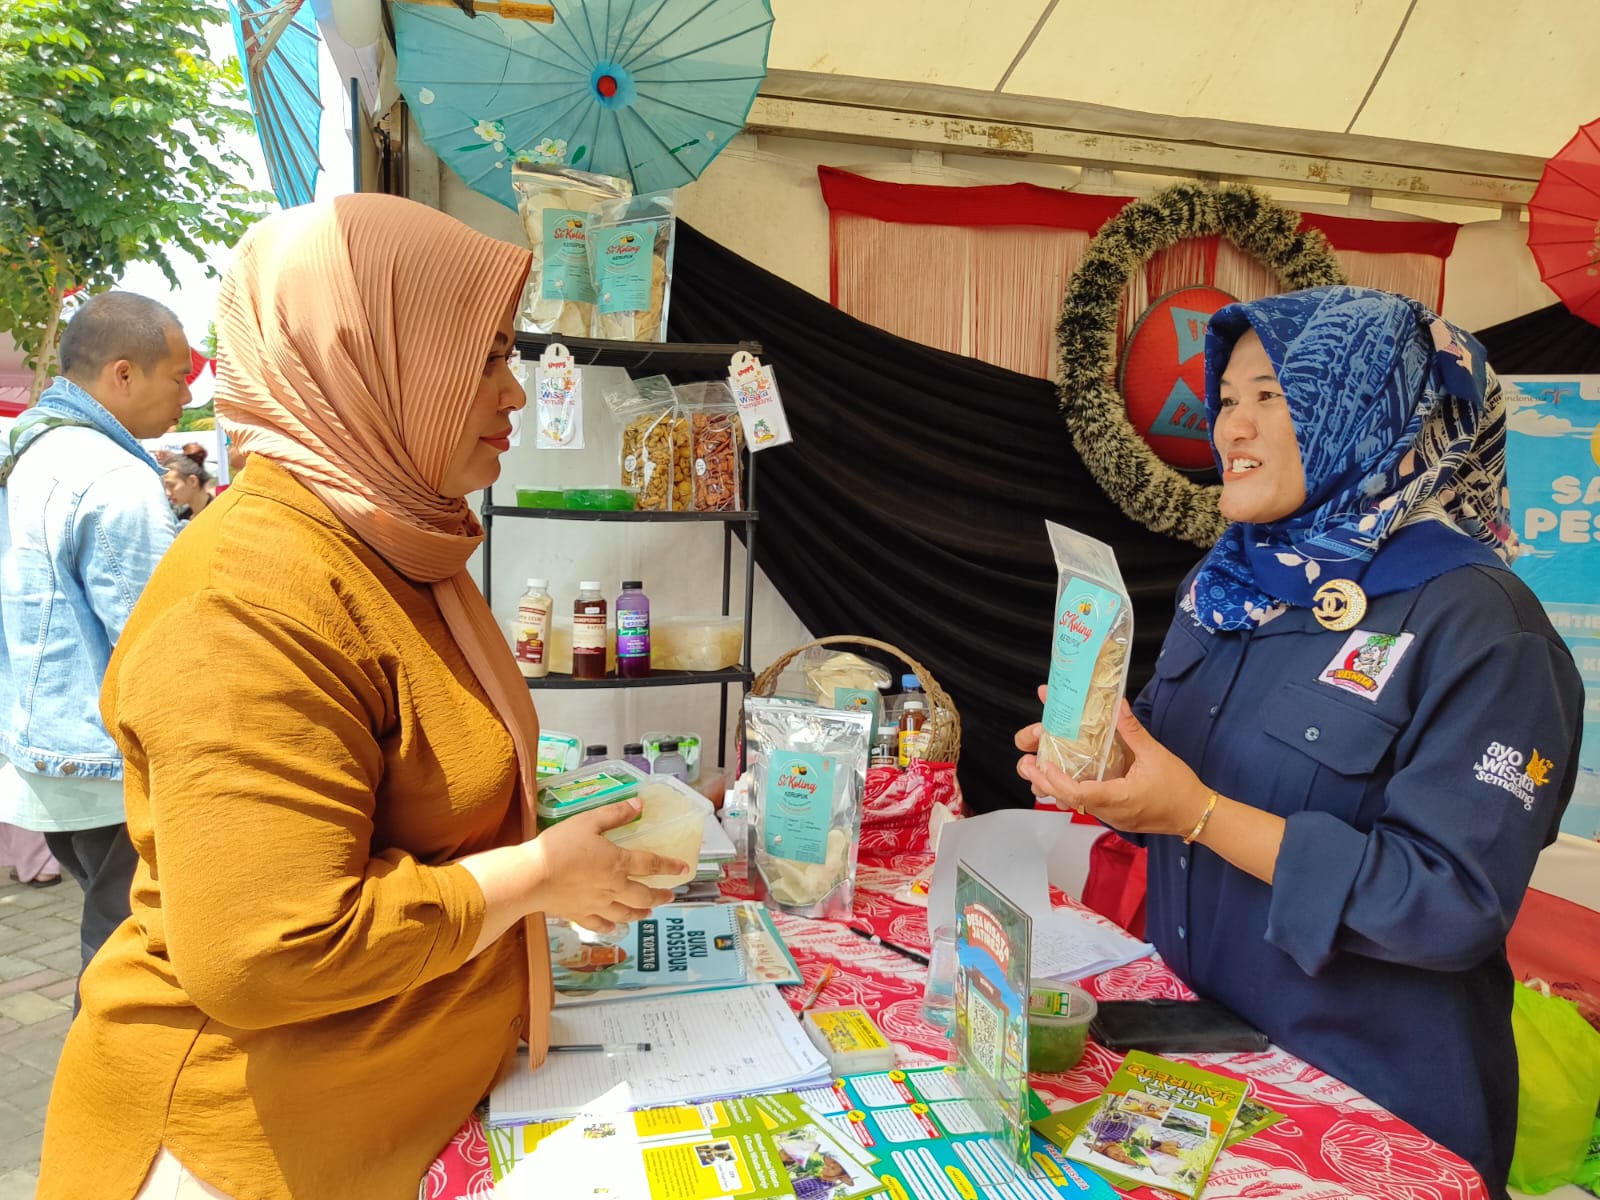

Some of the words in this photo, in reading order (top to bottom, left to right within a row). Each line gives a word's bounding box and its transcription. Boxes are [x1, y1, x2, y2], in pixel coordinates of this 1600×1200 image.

[1525, 508, 1600, 543] PE
[1486, 741, 1523, 766] ayo
[1475, 770, 1535, 811] semarang
[1482, 754, 1535, 793] wisata
[642, 923, 656, 934] SI
[666, 917, 688, 973] PROSEDUR
[687, 930, 709, 958] BUKU
[642, 935, 656, 970] KOLING
[1126, 1063, 1235, 1104] JATIREJO
[1136, 1074, 1215, 1107] WISATA
[1144, 1085, 1199, 1110] DESA
